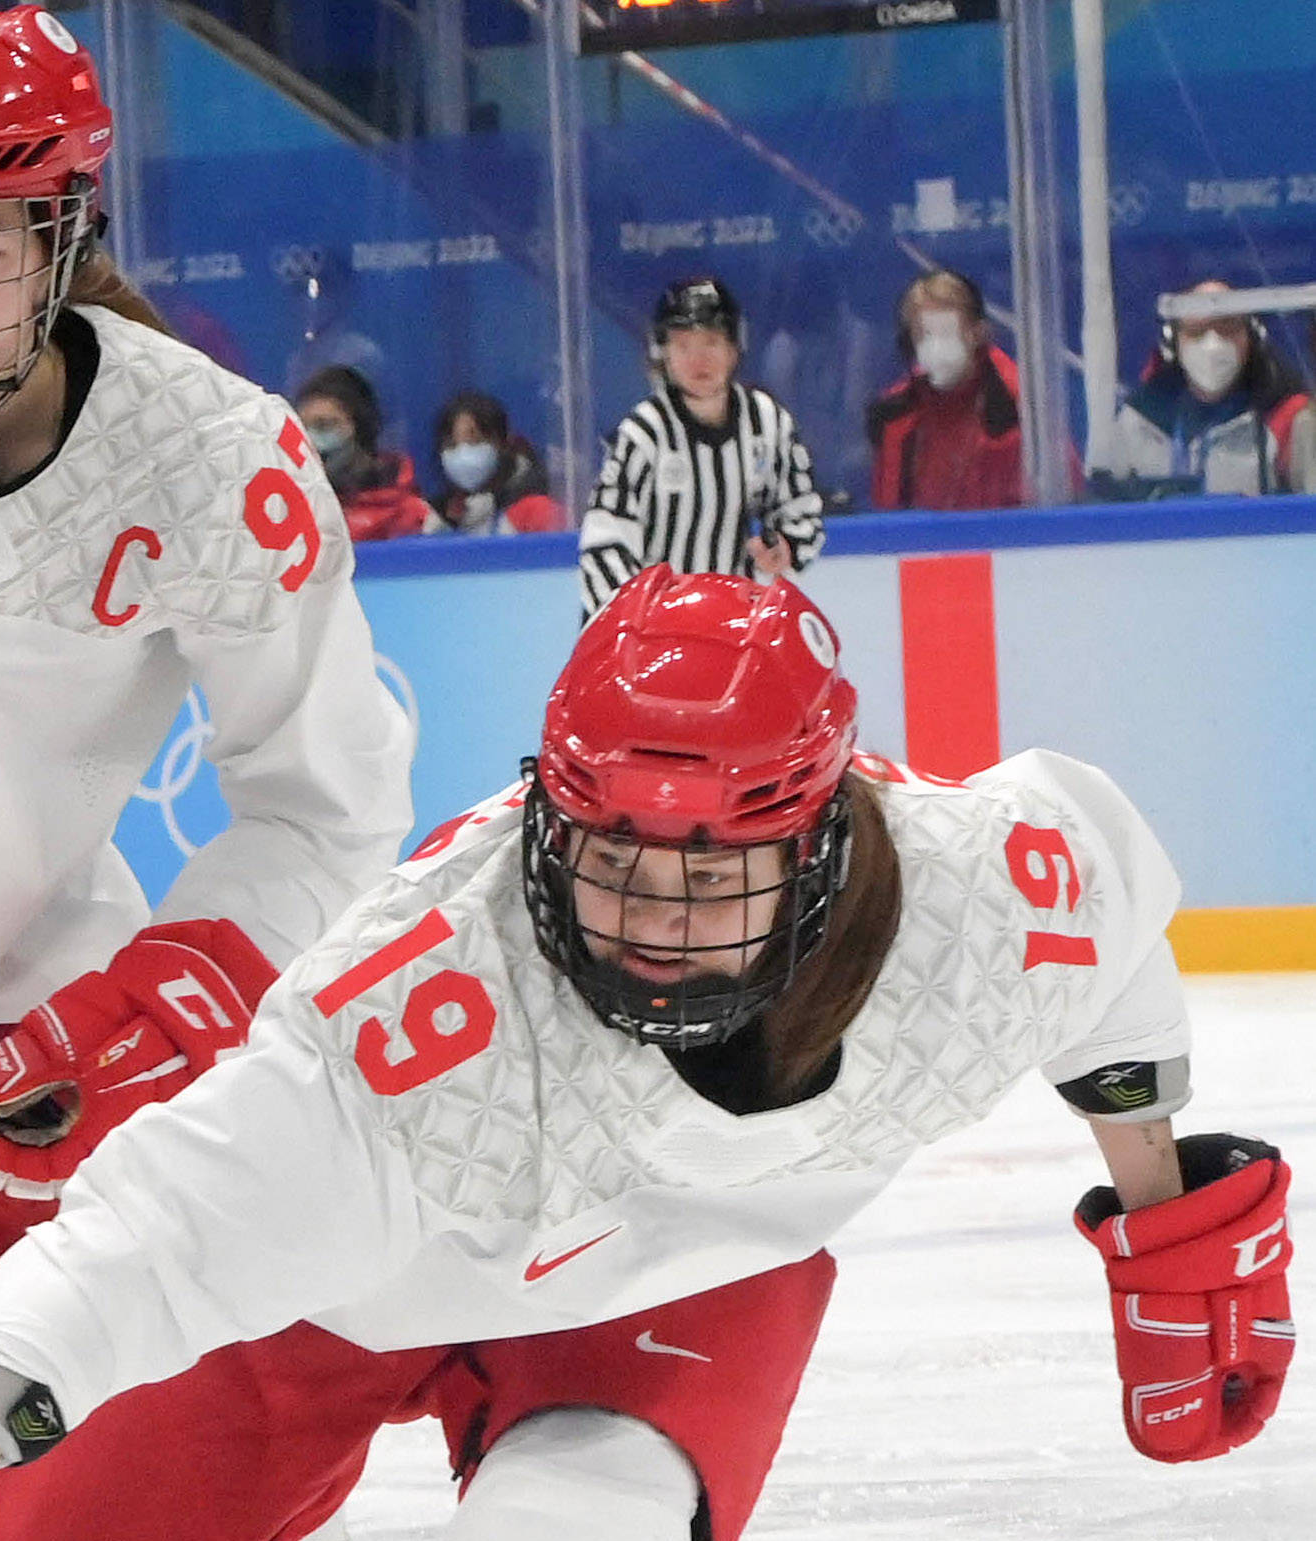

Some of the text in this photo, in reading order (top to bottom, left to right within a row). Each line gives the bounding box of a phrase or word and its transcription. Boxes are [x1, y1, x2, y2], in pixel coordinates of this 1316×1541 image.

[91, 524, 163, 628] C
[1003, 820, 1097, 973] 19
[312, 907, 498, 1097] 19
[1145, 1396, 1204, 1426] CCM
